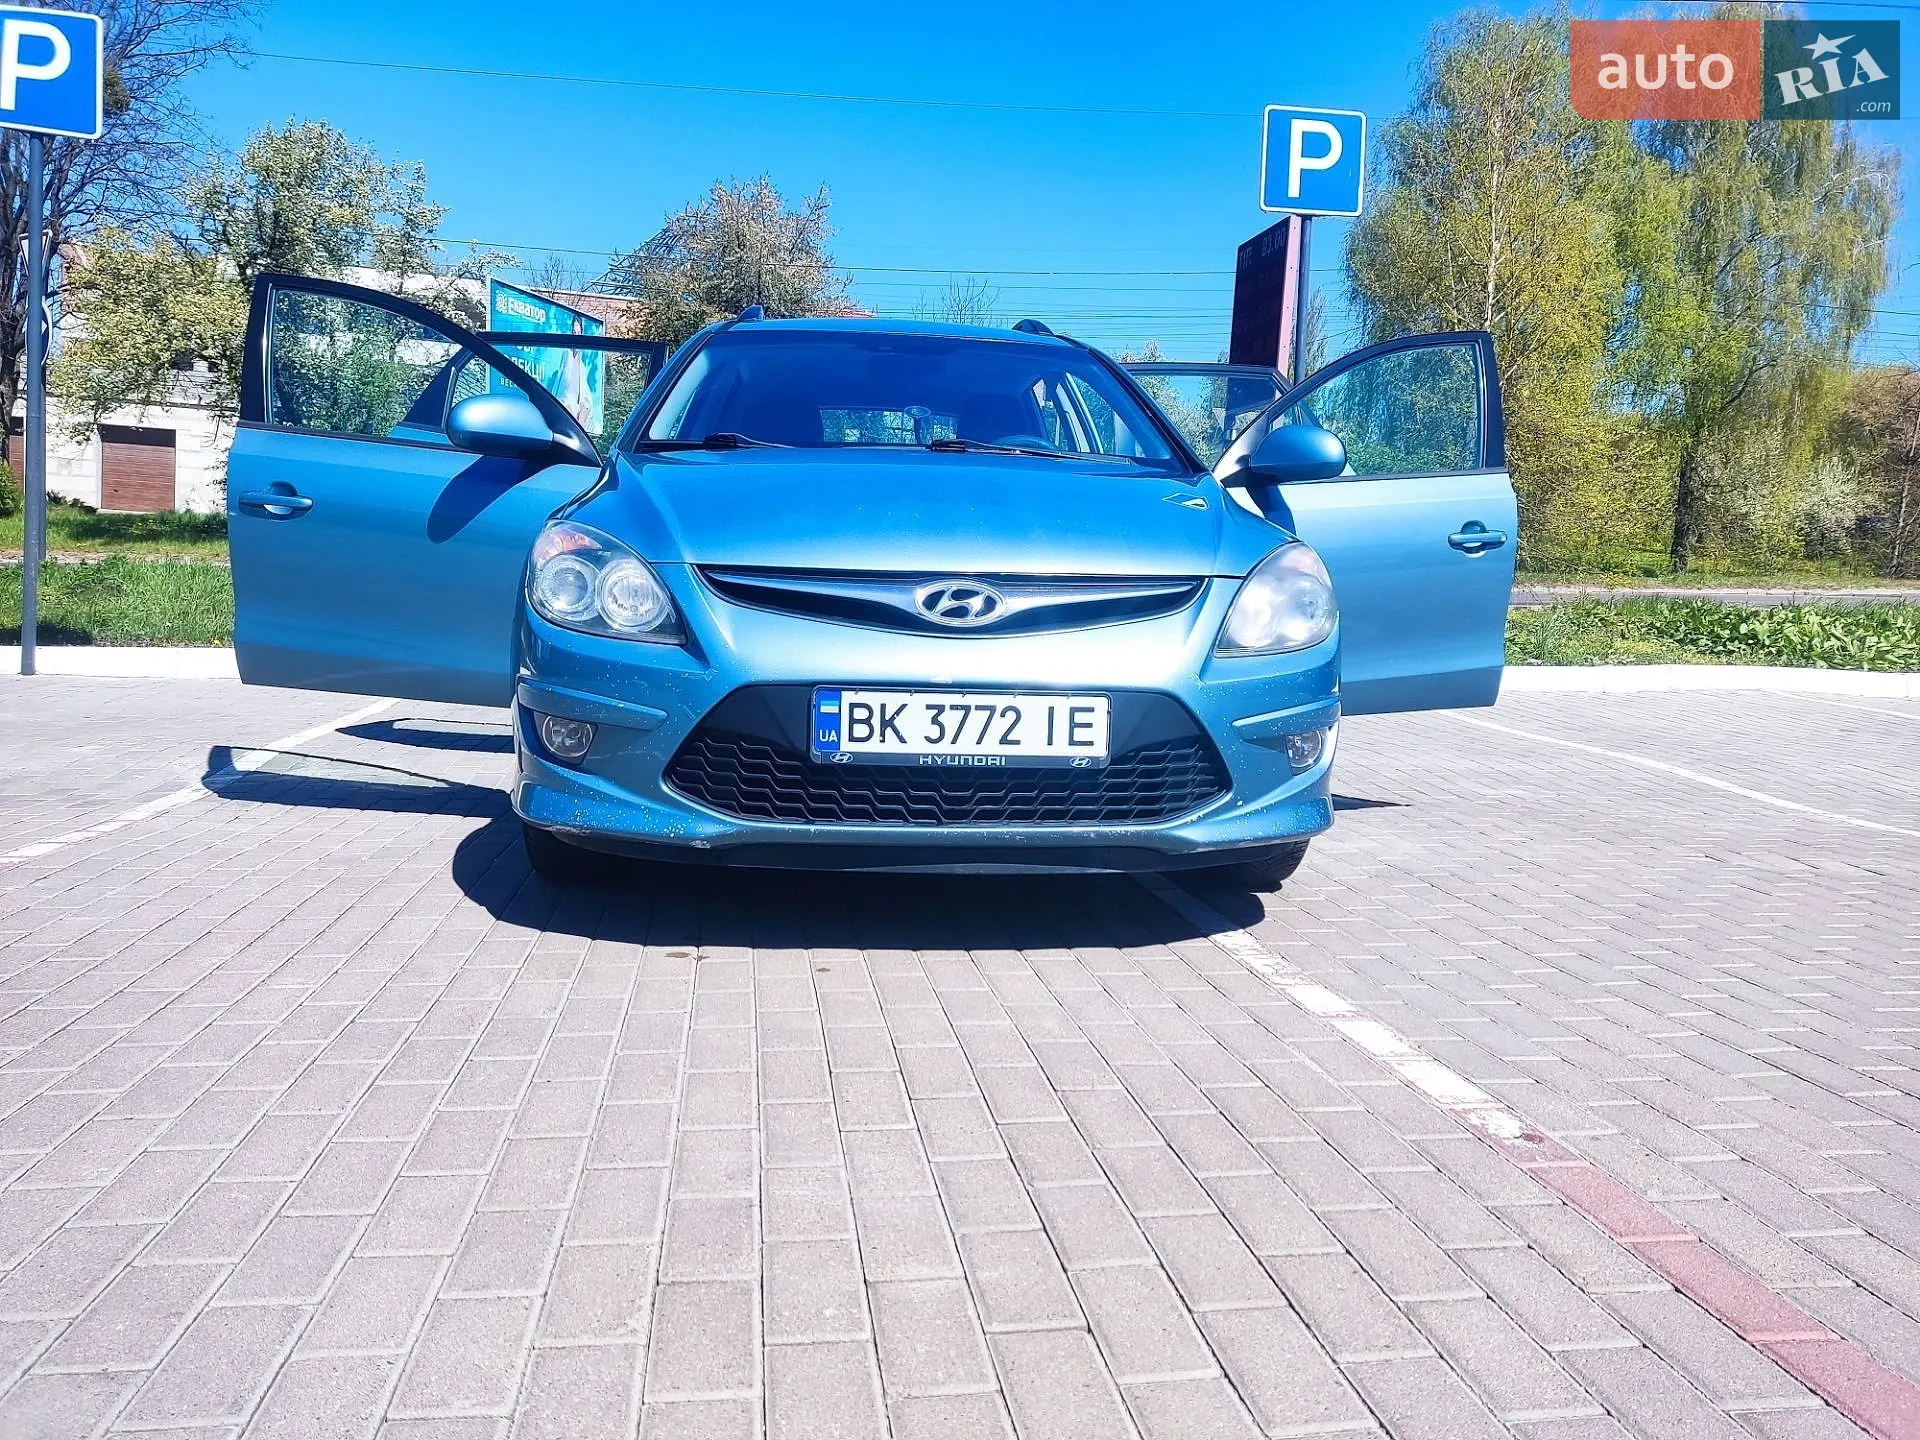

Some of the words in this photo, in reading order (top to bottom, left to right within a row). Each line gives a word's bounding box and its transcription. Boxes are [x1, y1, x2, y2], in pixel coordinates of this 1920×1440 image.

[0, 18, 71, 111] P
[1287, 118, 1343, 198] P
[819, 730, 838, 743] UA
[847, 702, 908, 744] BK
[923, 704, 1022, 745] 3772
[1047, 706, 1095, 747] IE
[919, 755, 1006, 767] HYUNDAI
